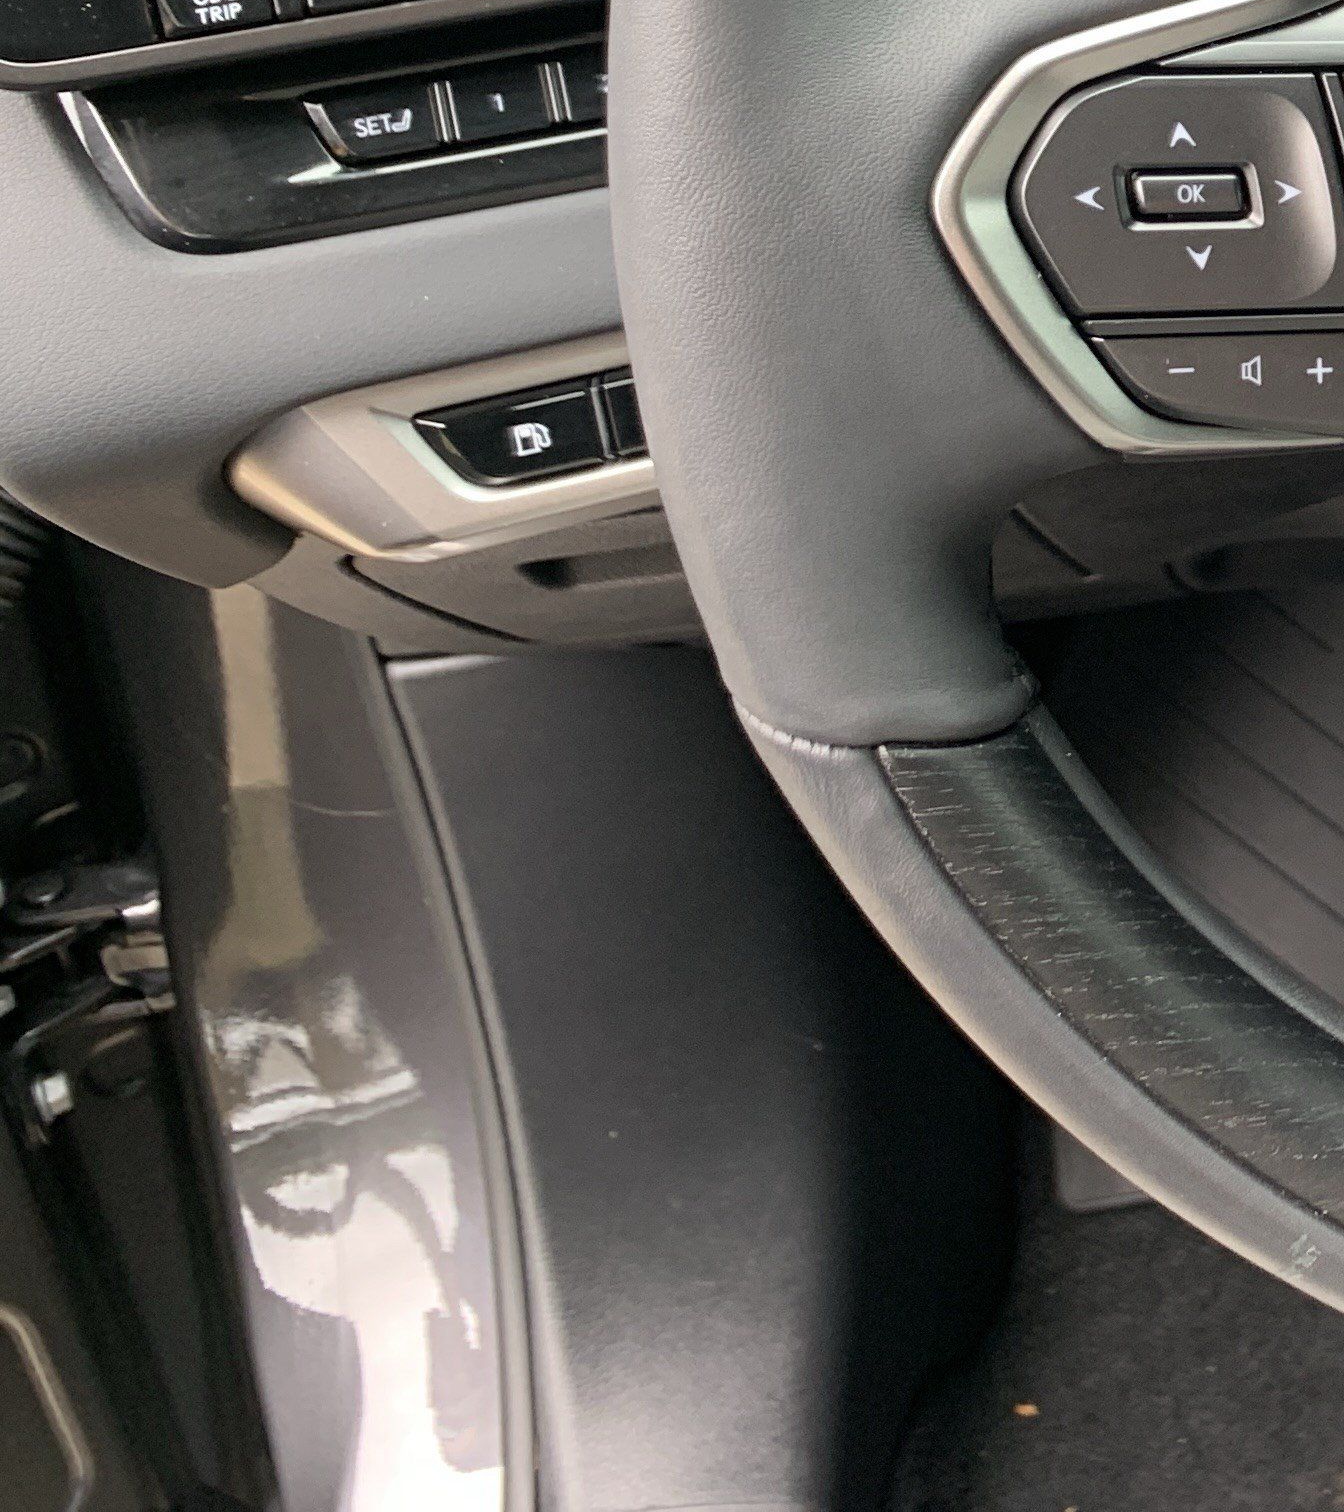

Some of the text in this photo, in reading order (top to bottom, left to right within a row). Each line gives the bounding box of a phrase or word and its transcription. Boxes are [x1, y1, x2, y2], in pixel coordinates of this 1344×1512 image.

[195, 2, 243, 25] TRIP
[353, 114, 391, 139] SET
[1176, 183, 1206, 205] OK
